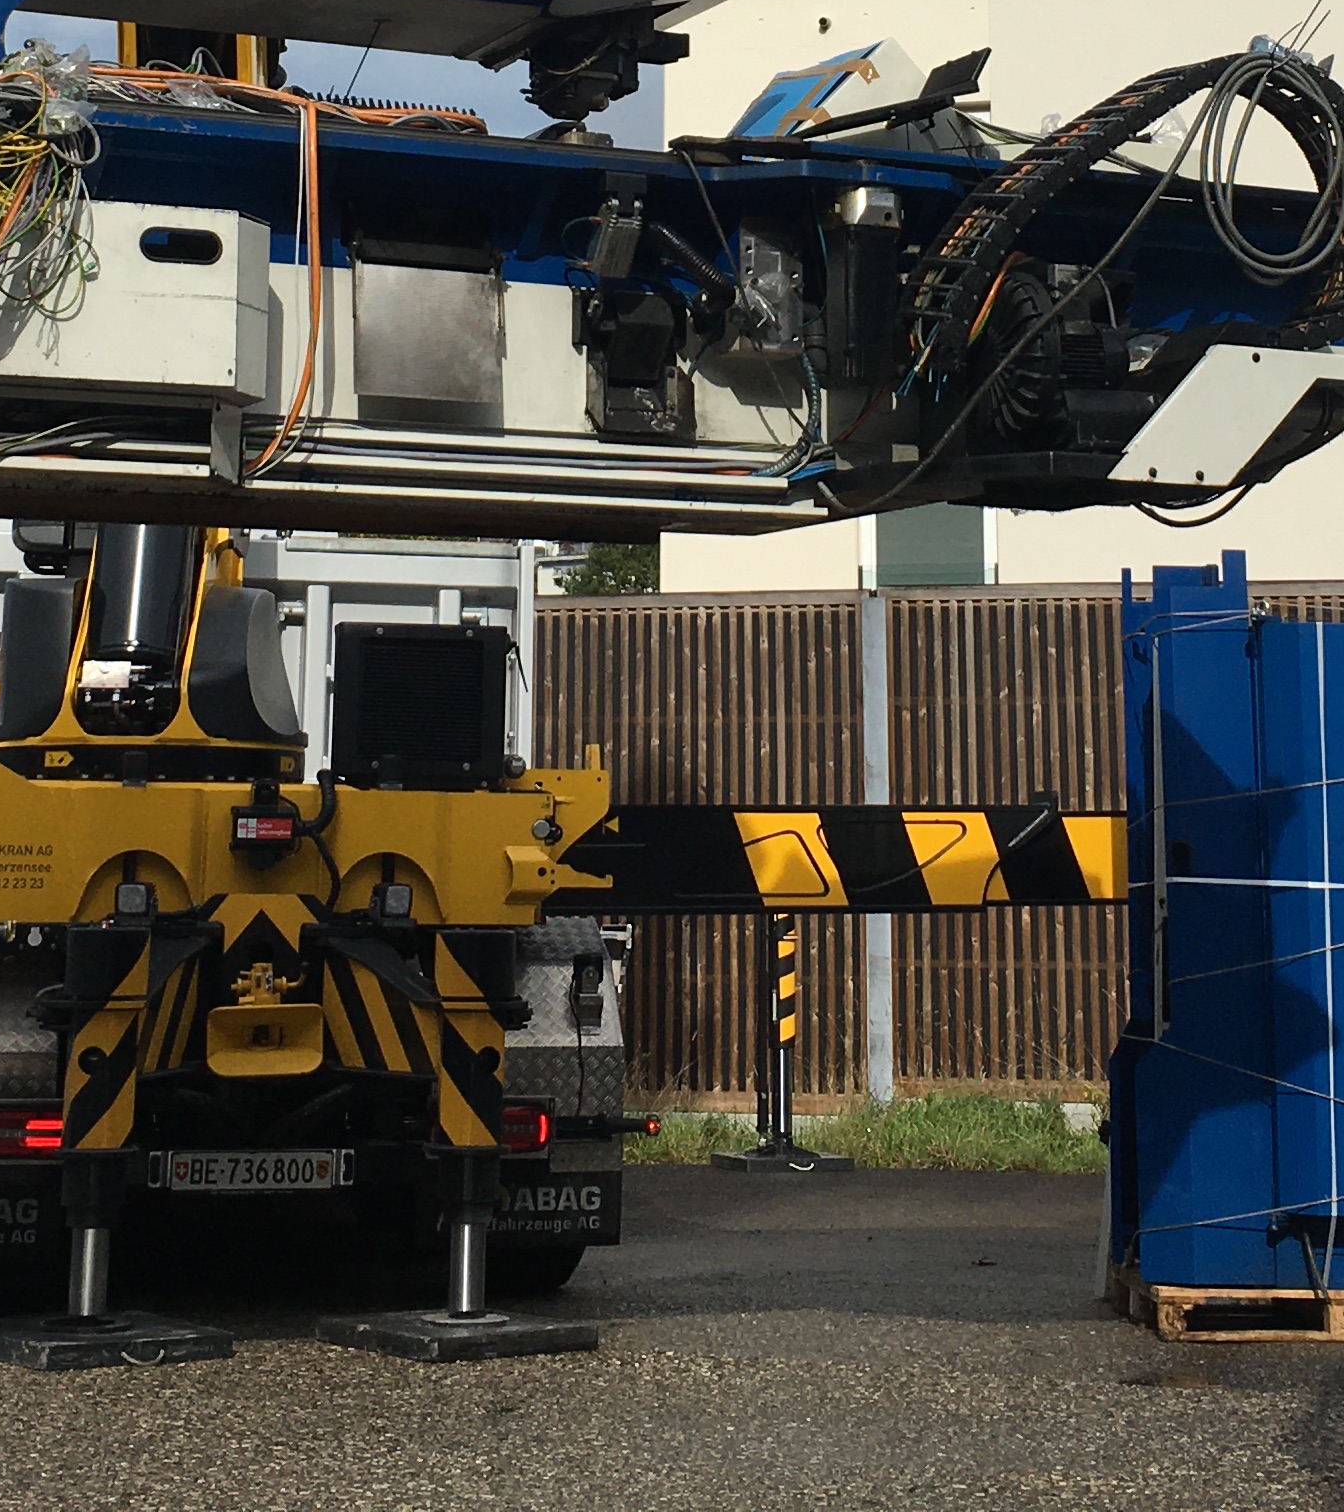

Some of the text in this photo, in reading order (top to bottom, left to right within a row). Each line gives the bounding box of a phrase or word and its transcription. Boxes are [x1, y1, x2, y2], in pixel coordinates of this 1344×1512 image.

[36, 844, 53, 856] AG
[12, 877, 27, 889] 23
[29, 877, 44, 889] 23
[514, 1186, 601, 1211] ABAG
[577, 1216, 601, 1229] AG
[10, 1229, 37, 1244] AG
